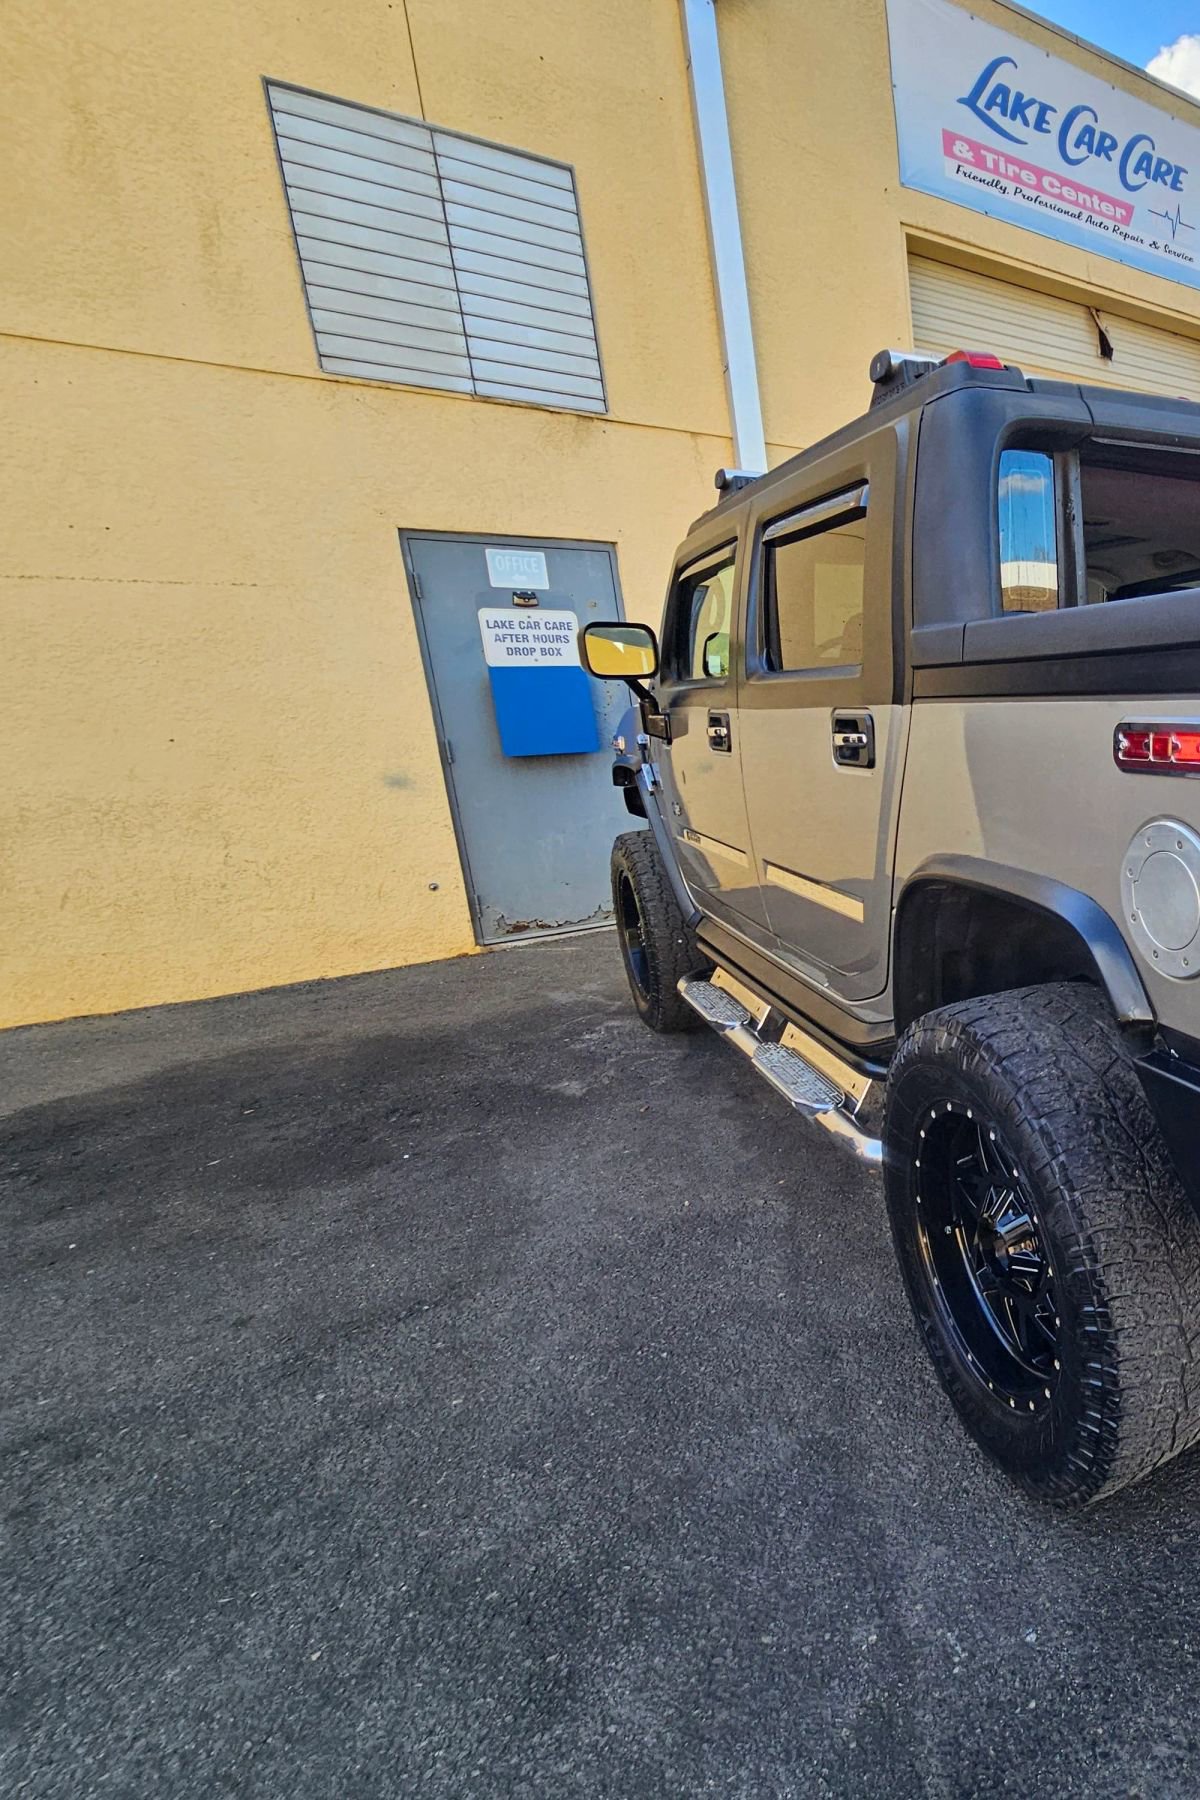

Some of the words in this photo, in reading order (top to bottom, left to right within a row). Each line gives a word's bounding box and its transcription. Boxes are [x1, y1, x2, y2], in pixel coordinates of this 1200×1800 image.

[956, 56, 1057, 145] LAKE
[1058, 105, 1118, 166] CAR
[1119, 134, 1188, 192] CARE
[952, 140, 976, 163] &
[980, 149, 1037, 185] Tire
[1042, 175, 1127, 220] Center
[1014, 186, 1083, 221] Professional
[1085, 214, 1110, 232] Auto
[1112, 224, 1145, 245] Repair
[1148, 239, 1161, 250] &
[1164, 243, 1195, 263] Service
[495, 555, 539, 573] OFFICE
[486, 619, 515, 630] LAKE
[519, 621, 541, 630] CAR
[545, 621, 573, 631] CARE
[494, 634, 529, 643] AFTER
[533, 634, 570, 643] HOURS
[506, 647, 536, 656] DROP
[541, 647, 563, 656] BOX
